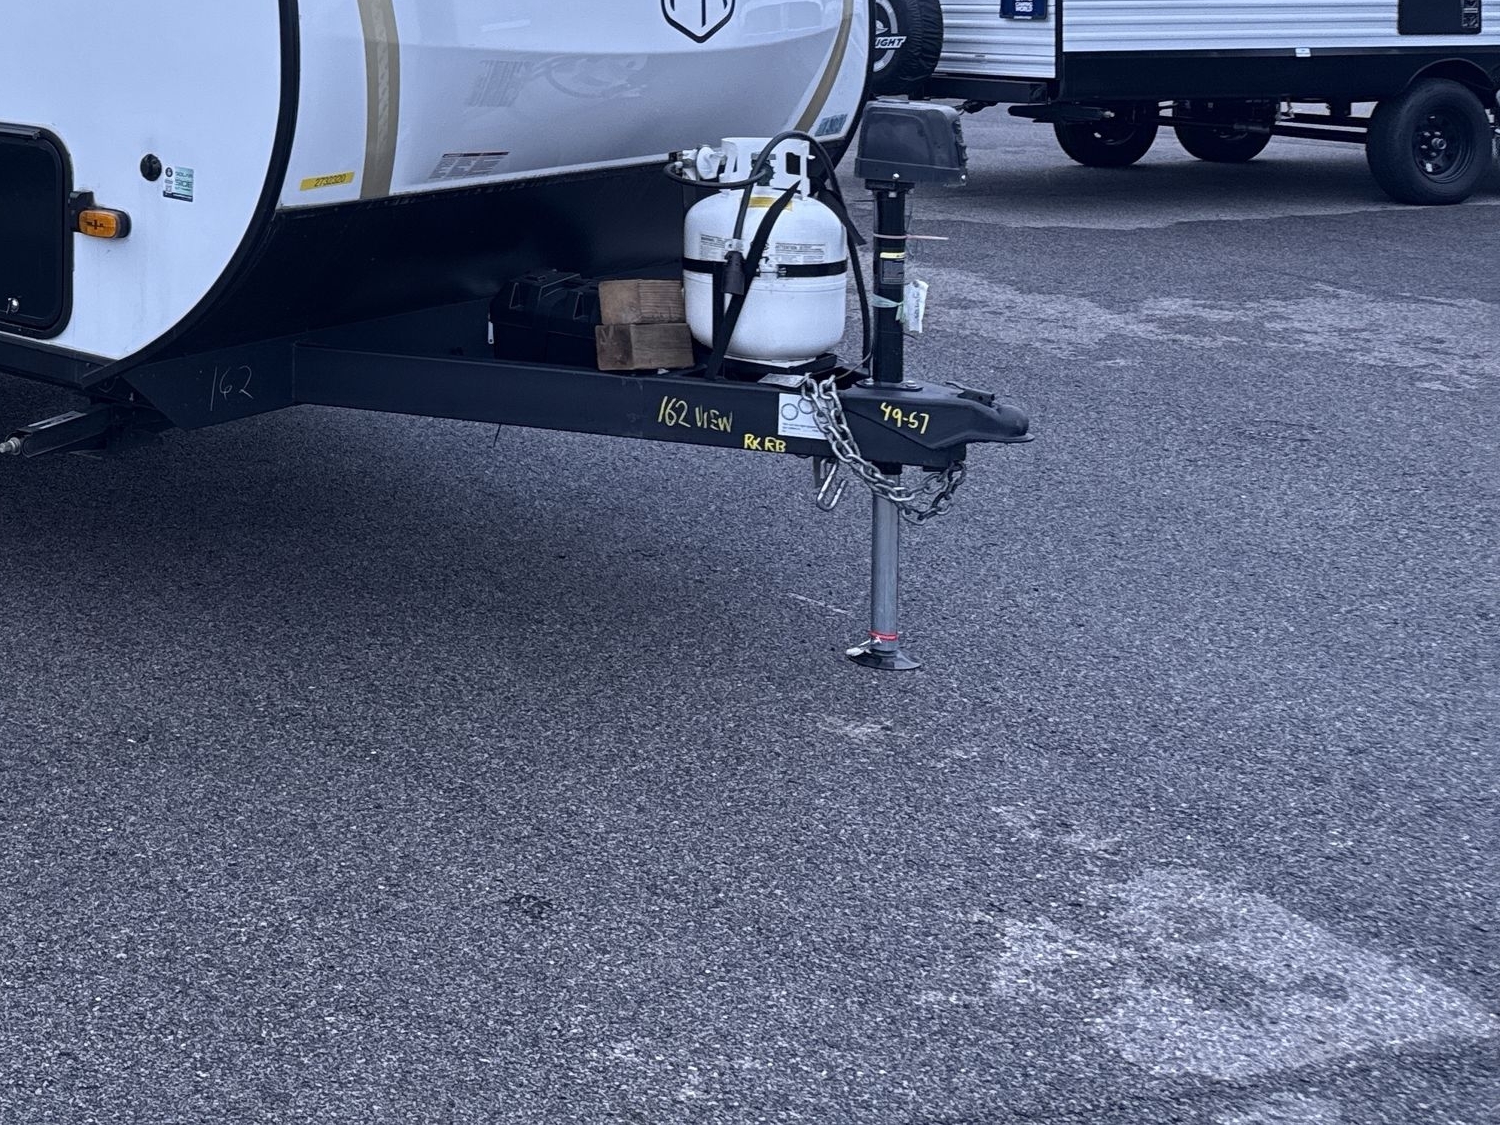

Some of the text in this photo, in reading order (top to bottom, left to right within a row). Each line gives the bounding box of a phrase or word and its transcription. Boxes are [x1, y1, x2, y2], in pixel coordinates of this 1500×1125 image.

[875, 36, 907, 49] IGHT
[657, 395, 734, 433] 162 VIEW
[879, 401, 930, 434] 49-57
